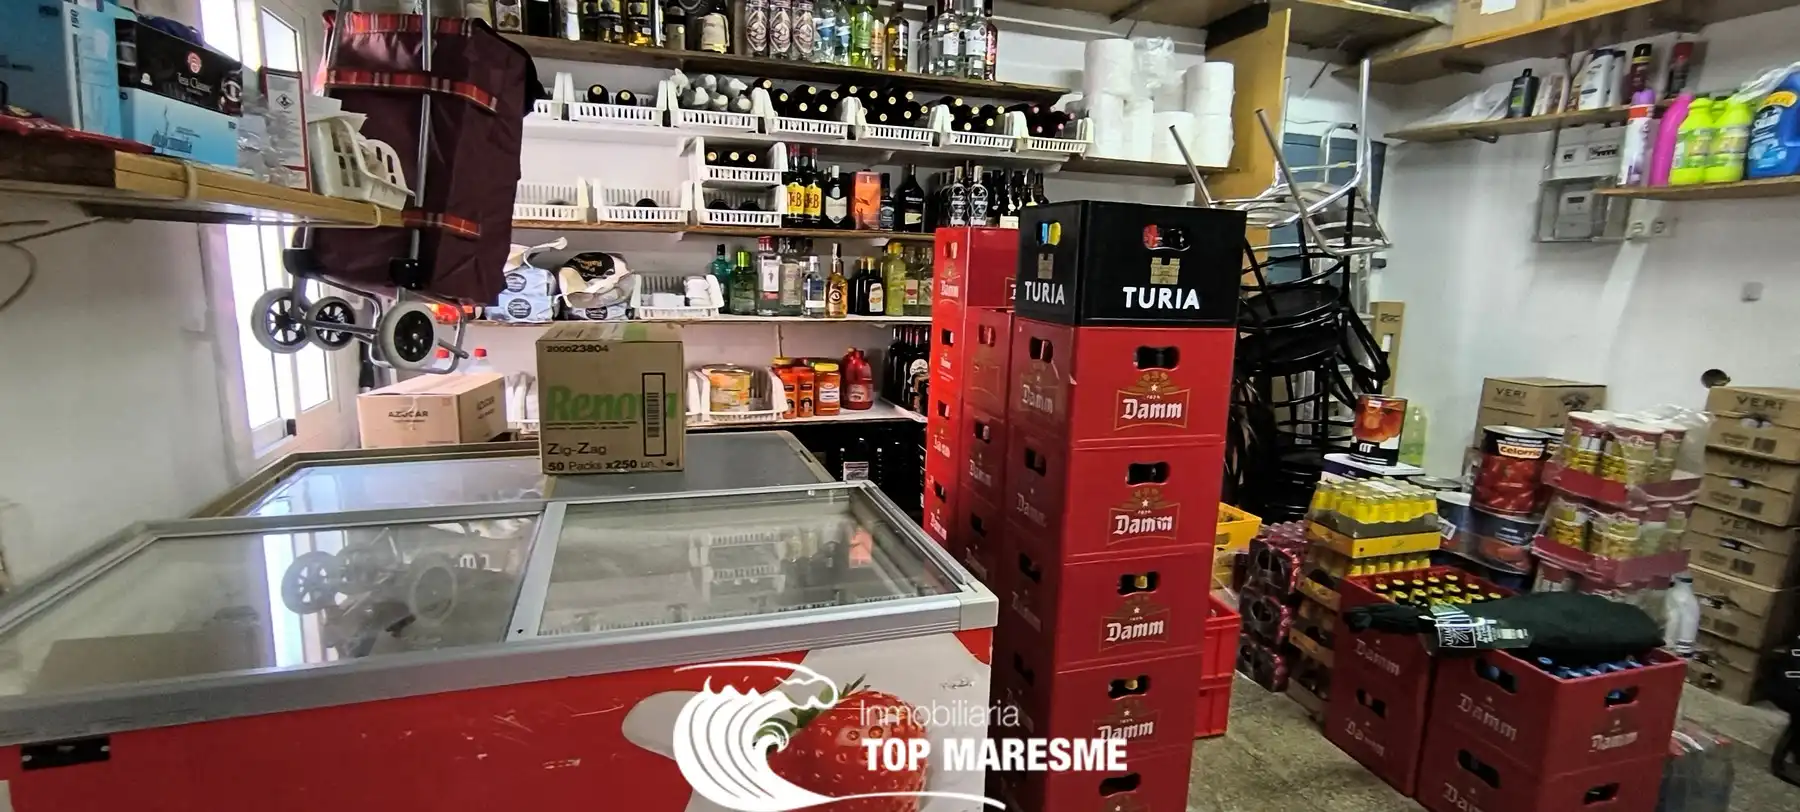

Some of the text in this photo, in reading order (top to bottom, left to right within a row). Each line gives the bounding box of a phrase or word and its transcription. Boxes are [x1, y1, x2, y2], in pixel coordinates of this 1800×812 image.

[1024, 281, 1065, 305] TURIA
[1122, 286, 1200, 310] TURIA
[1495, 387, 1527, 399] VERI
[1121, 398, 1183, 420] Damm
[547, 442, 607, 456] Zig-Zag
[548, 462, 564, 471] 50
[568, 460, 602, 471] Packs
[605, 460, 637, 470] x250
[1112, 514, 1173, 535] Damm
[1105, 620, 1164, 642] Damm
[1457, 692, 1517, 741] Damm
